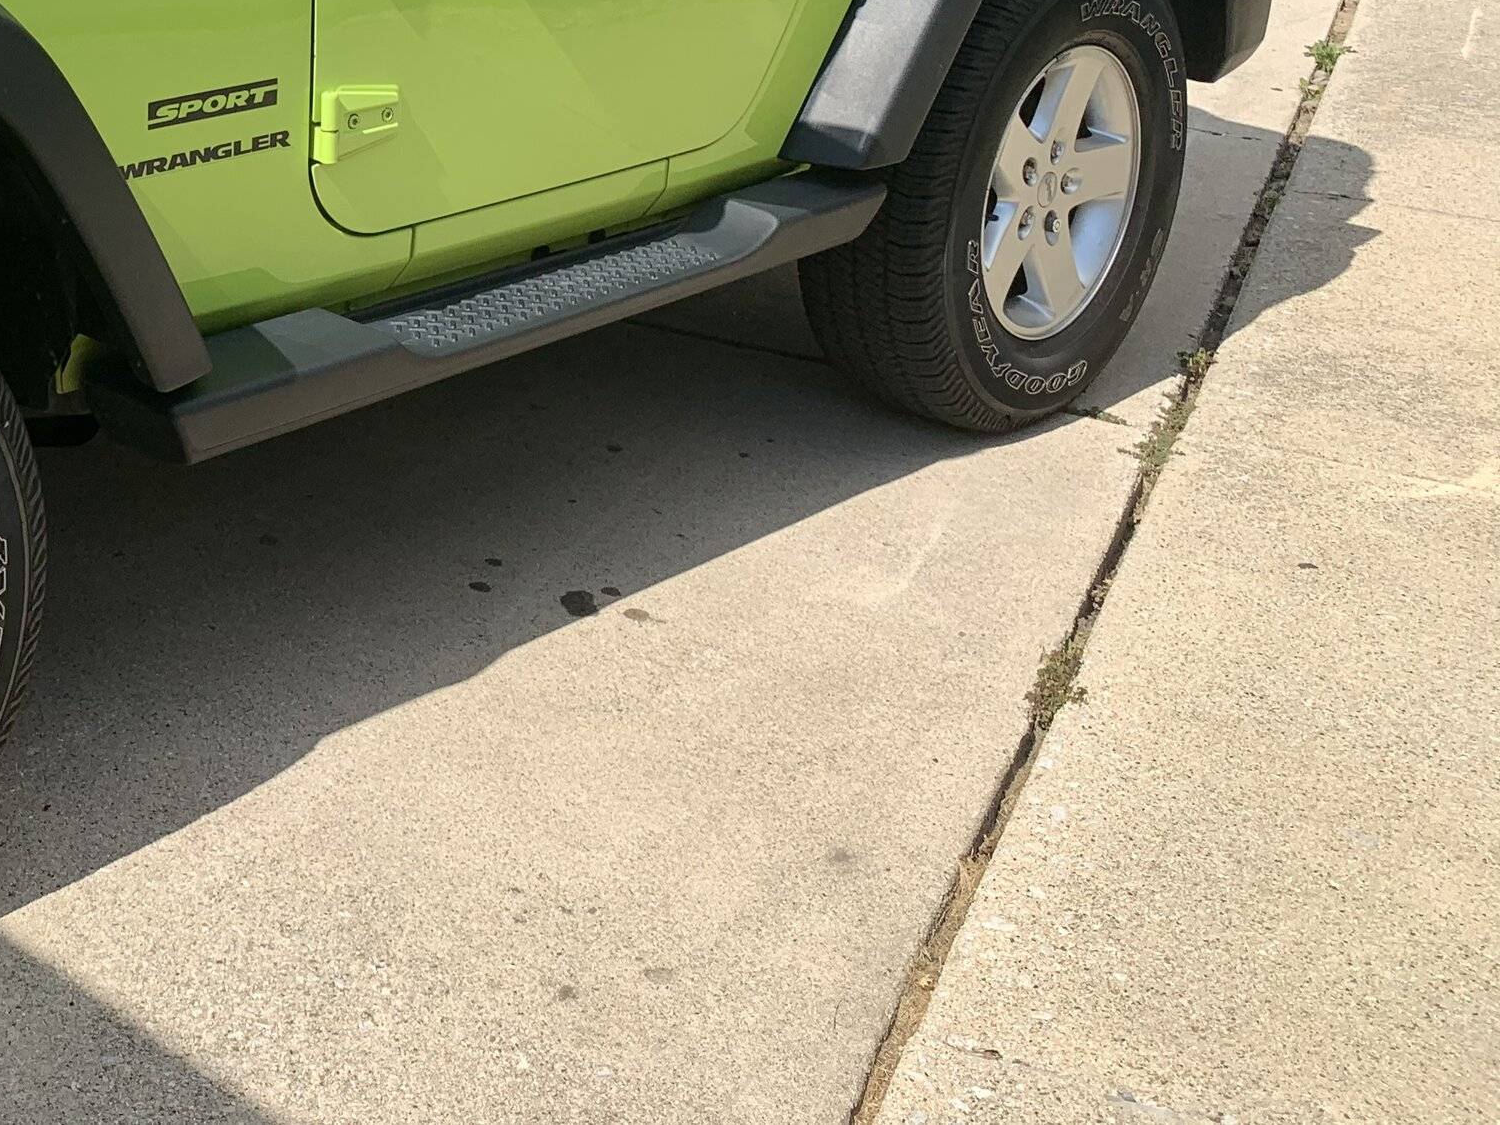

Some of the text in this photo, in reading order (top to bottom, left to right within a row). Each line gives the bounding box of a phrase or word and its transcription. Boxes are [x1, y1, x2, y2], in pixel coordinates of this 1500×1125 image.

[148, 81, 278, 128] SPORT
[117, 129, 291, 181] WRANGLER
[965, 238, 1088, 396] GOODYEAR
